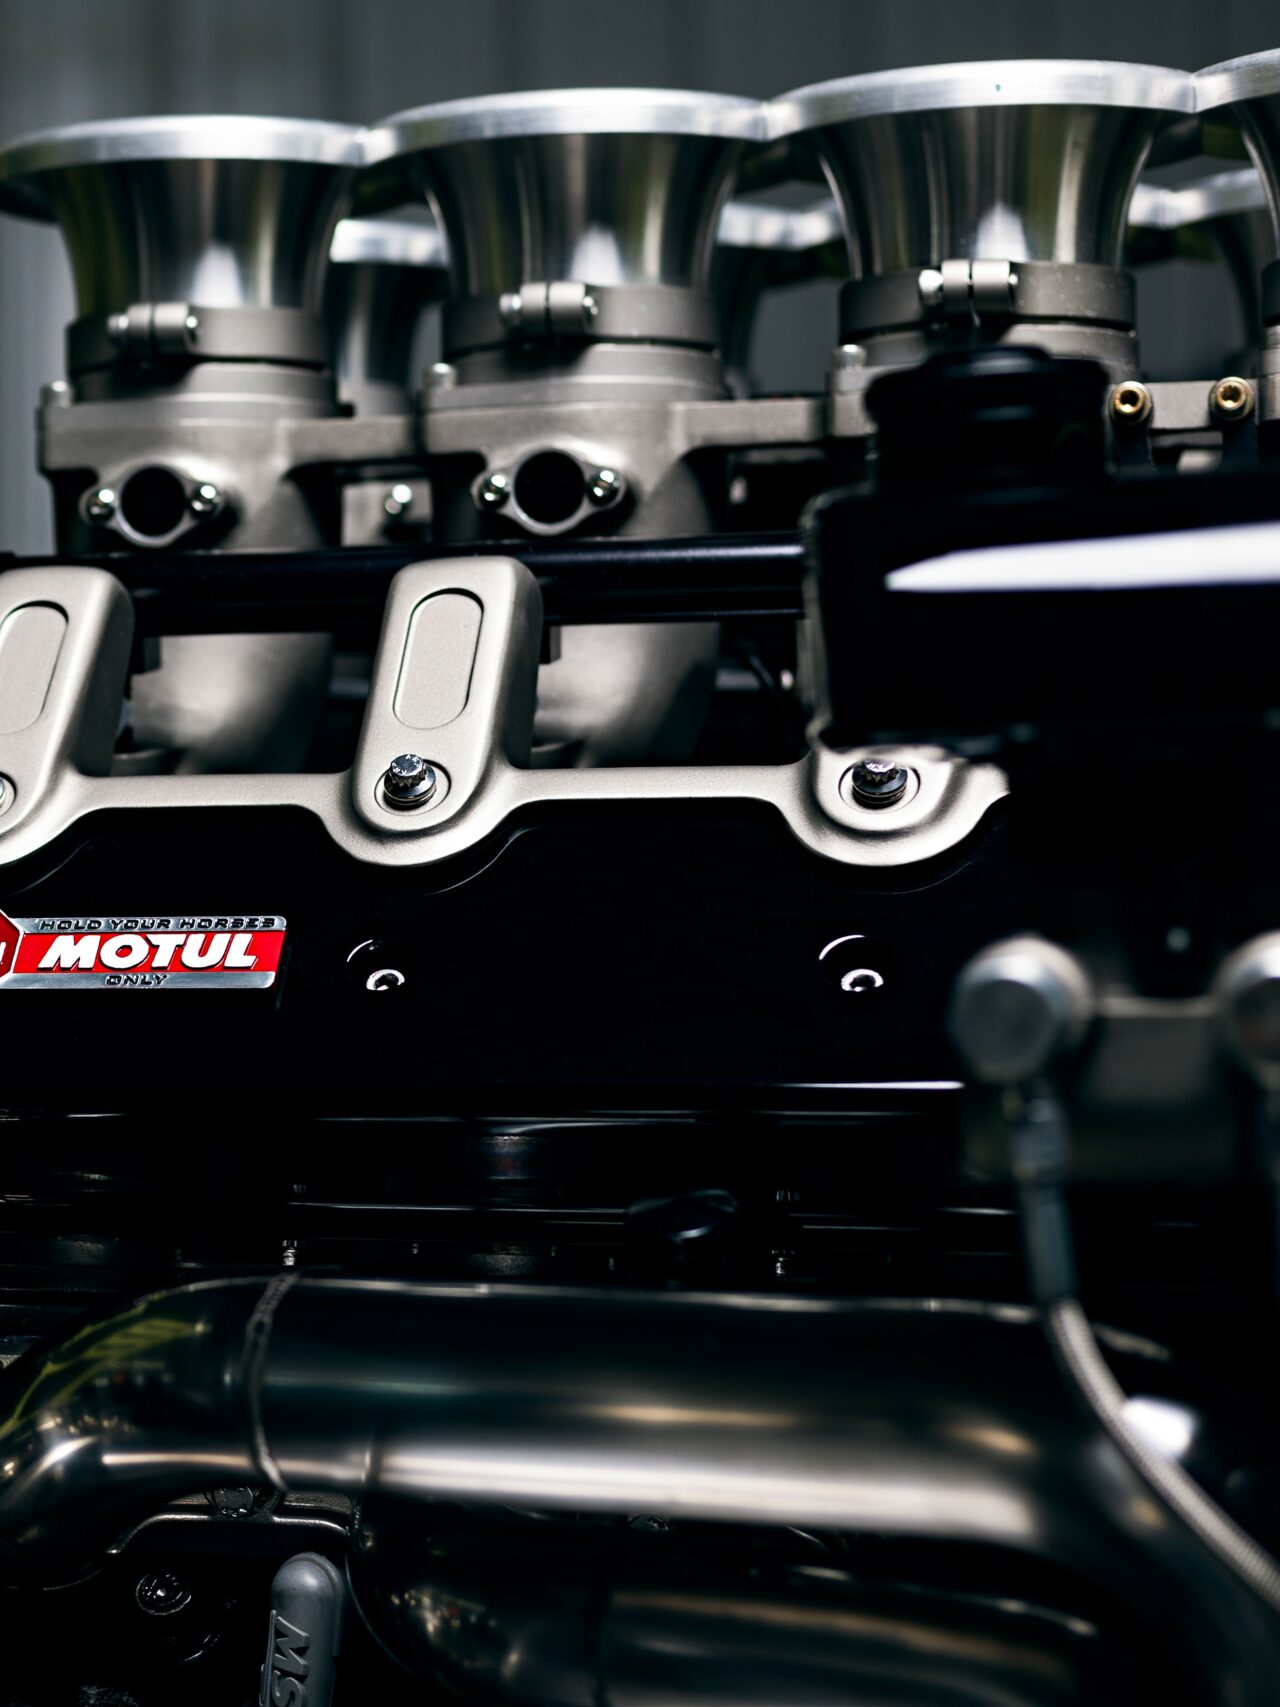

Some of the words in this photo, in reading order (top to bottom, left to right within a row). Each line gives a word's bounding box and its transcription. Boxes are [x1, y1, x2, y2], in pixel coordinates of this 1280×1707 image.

[40, 919, 102, 931] HOLD
[110, 918, 171, 930] YOUR
[180, 917, 275, 929] HORSES
[37, 934, 257, 970] MOTUL
[105, 974, 168, 986] ONLY
